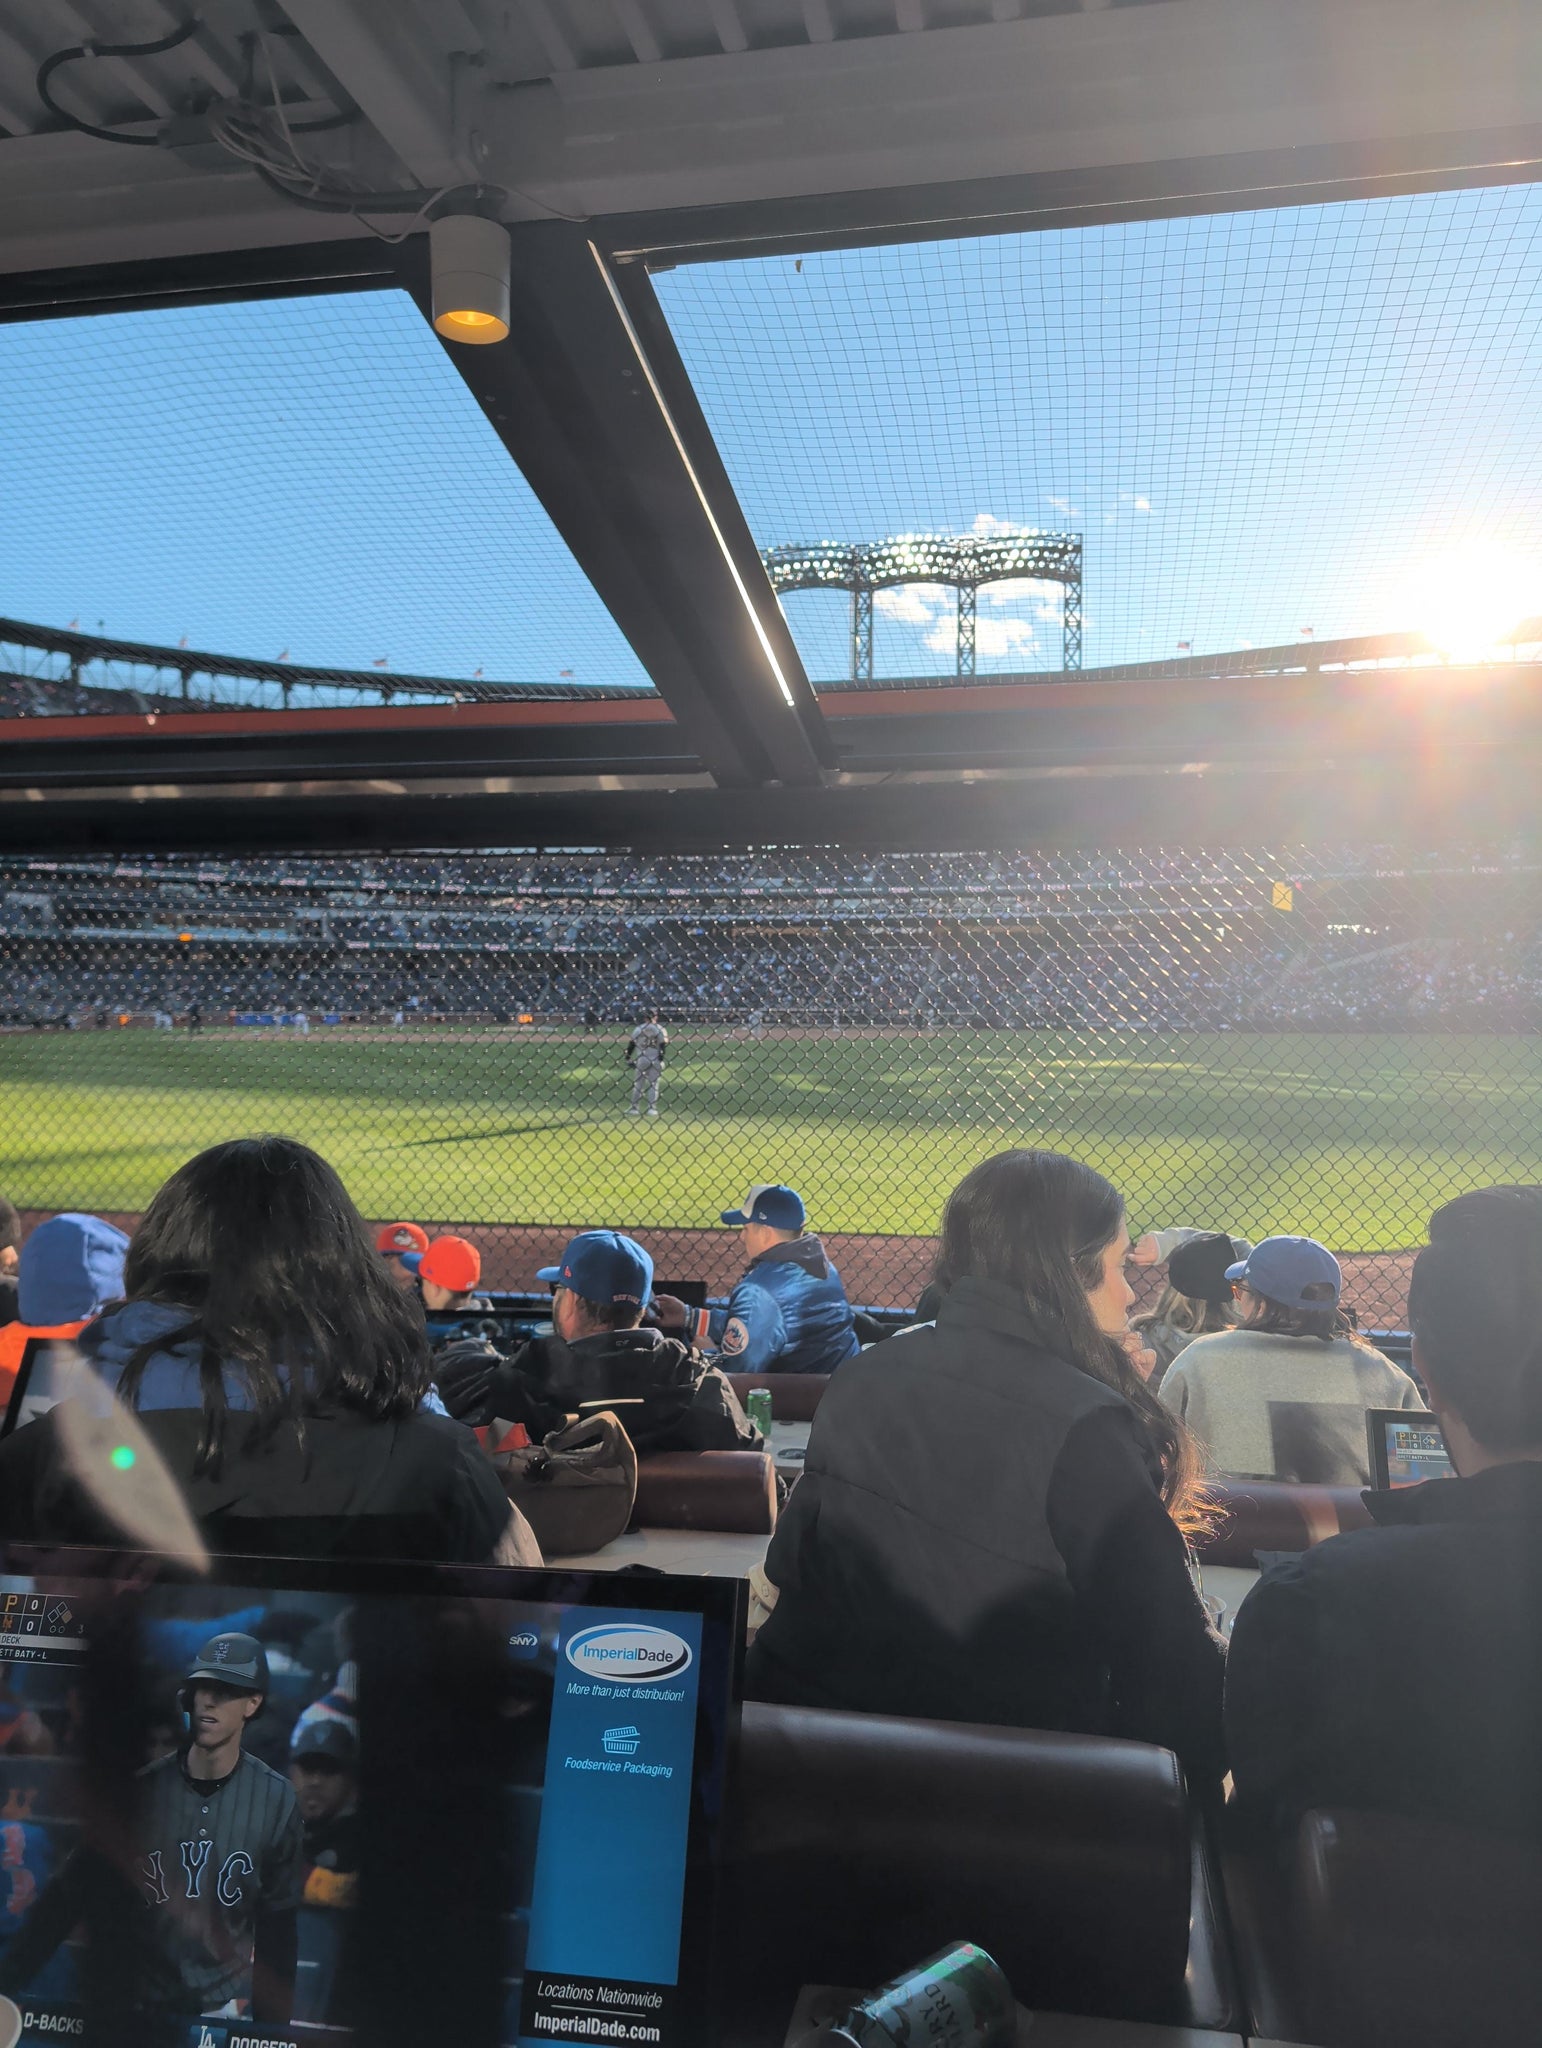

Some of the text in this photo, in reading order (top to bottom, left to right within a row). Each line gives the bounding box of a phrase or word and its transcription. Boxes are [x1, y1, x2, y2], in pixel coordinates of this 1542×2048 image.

[5, 1594, 39, 1613] P 0
[26, 1620, 34, 1632] 0
[1, 1635, 22, 1645] DECK
[508, 1635, 535, 1646] SNY
[14, 1649, 36, 1659] BATY
[42, 1651, 47, 1660] L
[583, 1645, 674, 1663] ImperialDade
[566, 1683, 685, 1702] More than just distribution!
[564, 1757, 673, 1778] Foodservice Packaging
[537, 1980, 663, 2009] Locations Nationwide
[23, 2012, 84, 2035] D-BACKS
[534, 2012, 660, 2042] ImperialDade.com
